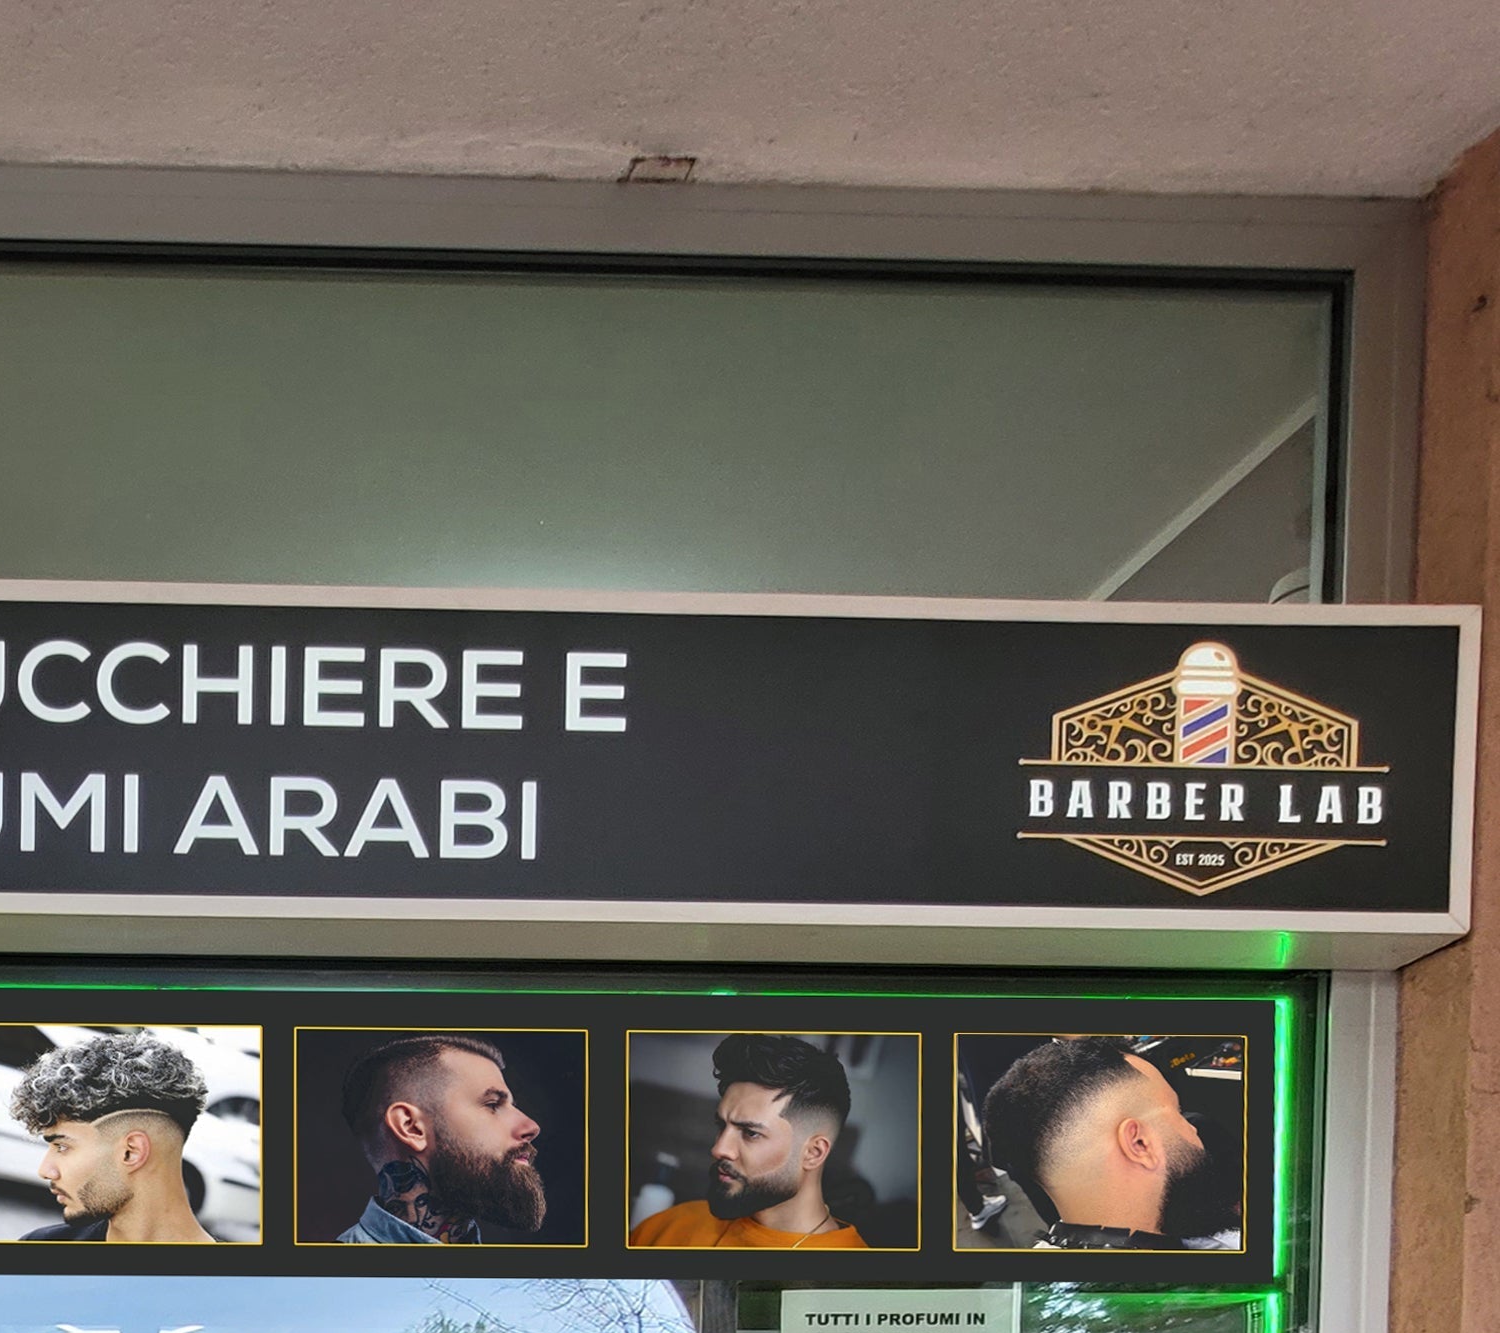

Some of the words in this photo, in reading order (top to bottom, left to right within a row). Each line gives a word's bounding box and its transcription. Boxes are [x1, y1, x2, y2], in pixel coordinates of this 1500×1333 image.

[566, 653, 627, 733] E
[173, 775, 538, 861] ARABI
[1028, 778, 1245, 823] BARBER
[1277, 784, 1384, 825] LAB
[1175, 853, 1195, 866] EST
[1198, 853, 1225, 867] 2025
[805, 1313, 860, 1326] TUTTI
[865, 1313, 870, 1326] I
[877, 1312, 961, 1326] PROFUMI
[966, 1313, 986, 1325] IN
